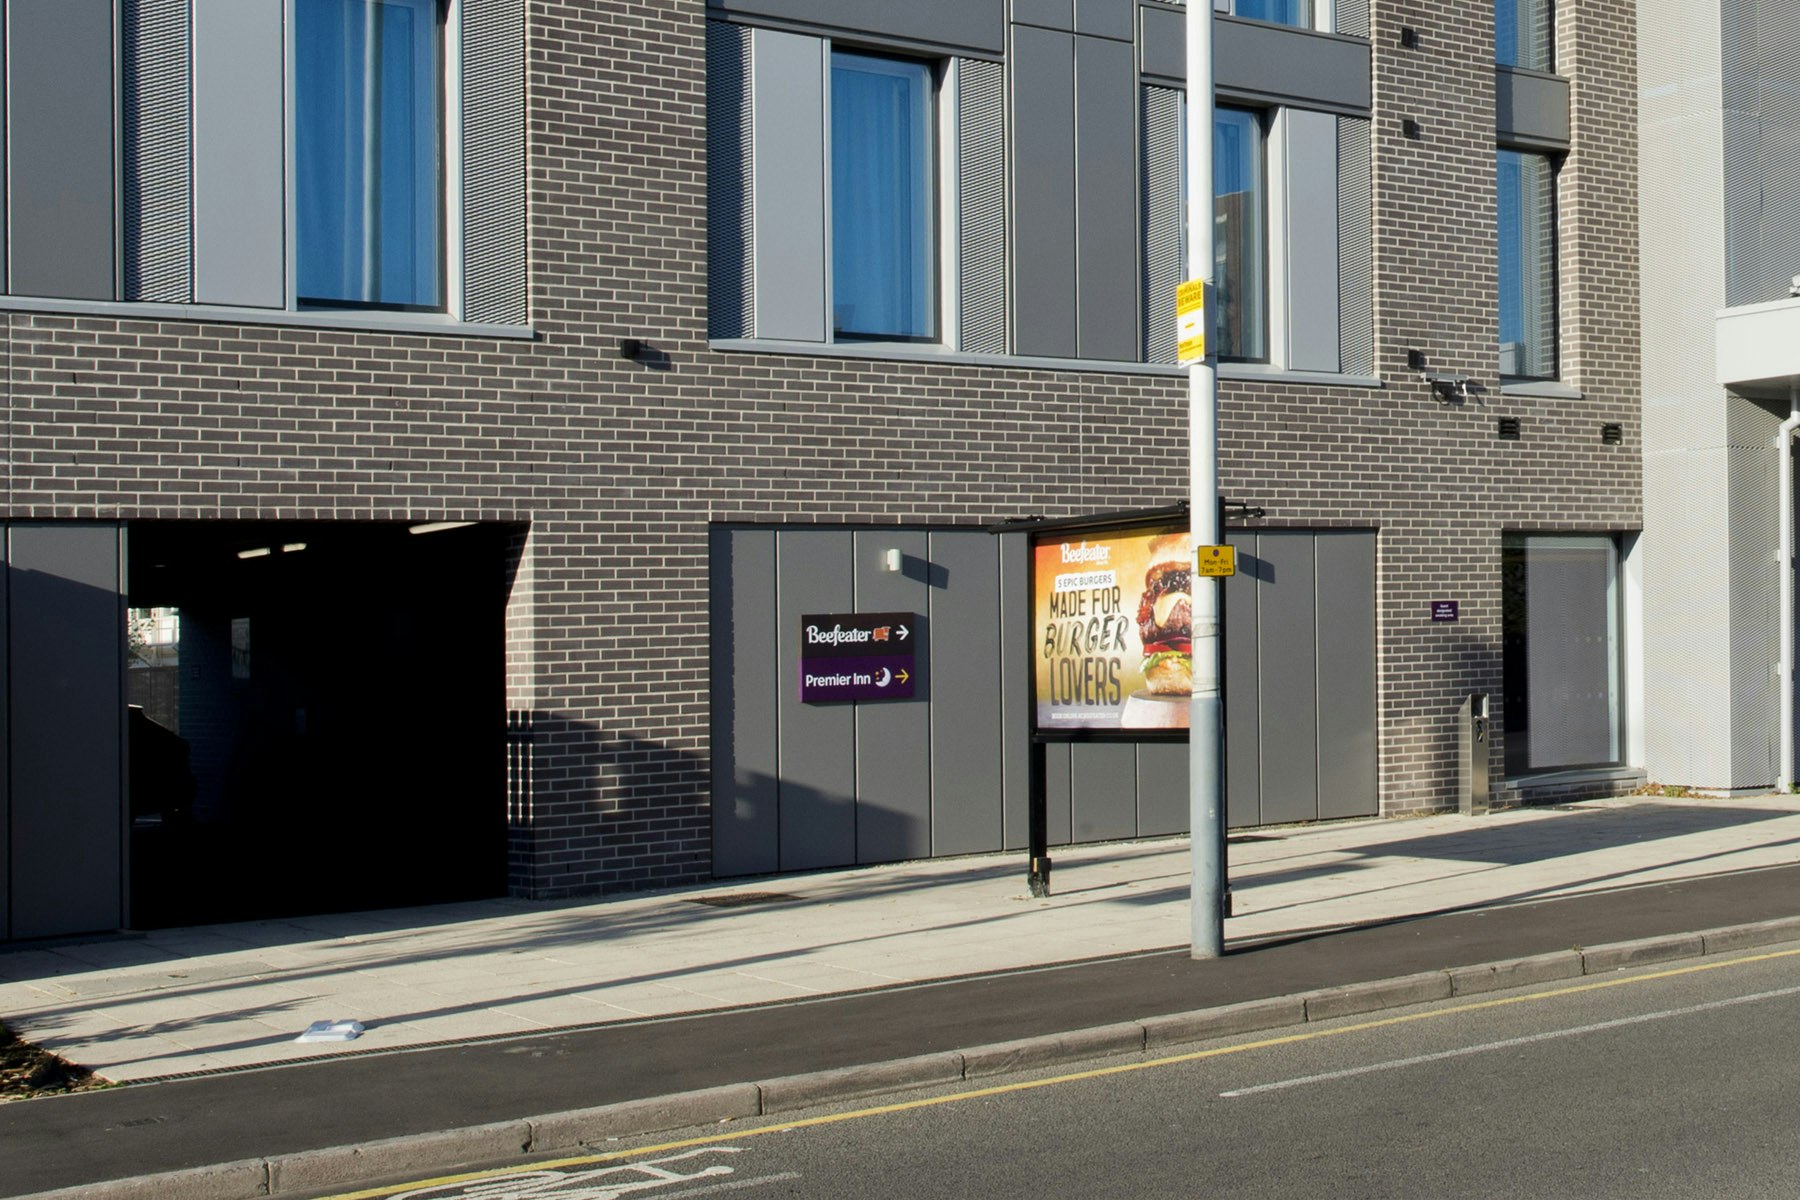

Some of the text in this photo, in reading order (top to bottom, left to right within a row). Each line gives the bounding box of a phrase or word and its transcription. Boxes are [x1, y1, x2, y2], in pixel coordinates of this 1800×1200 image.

[1058, 574, 1112, 588] 5 EPIC BURGERS
[1049, 586, 1121, 619] MADE FOR
[805, 623, 872, 647] Beefeater
[1043, 614, 1130, 659] BURGER
[805, 672, 871, 687] Premier Inn
[1050, 657, 1121, 706] LOVERS
